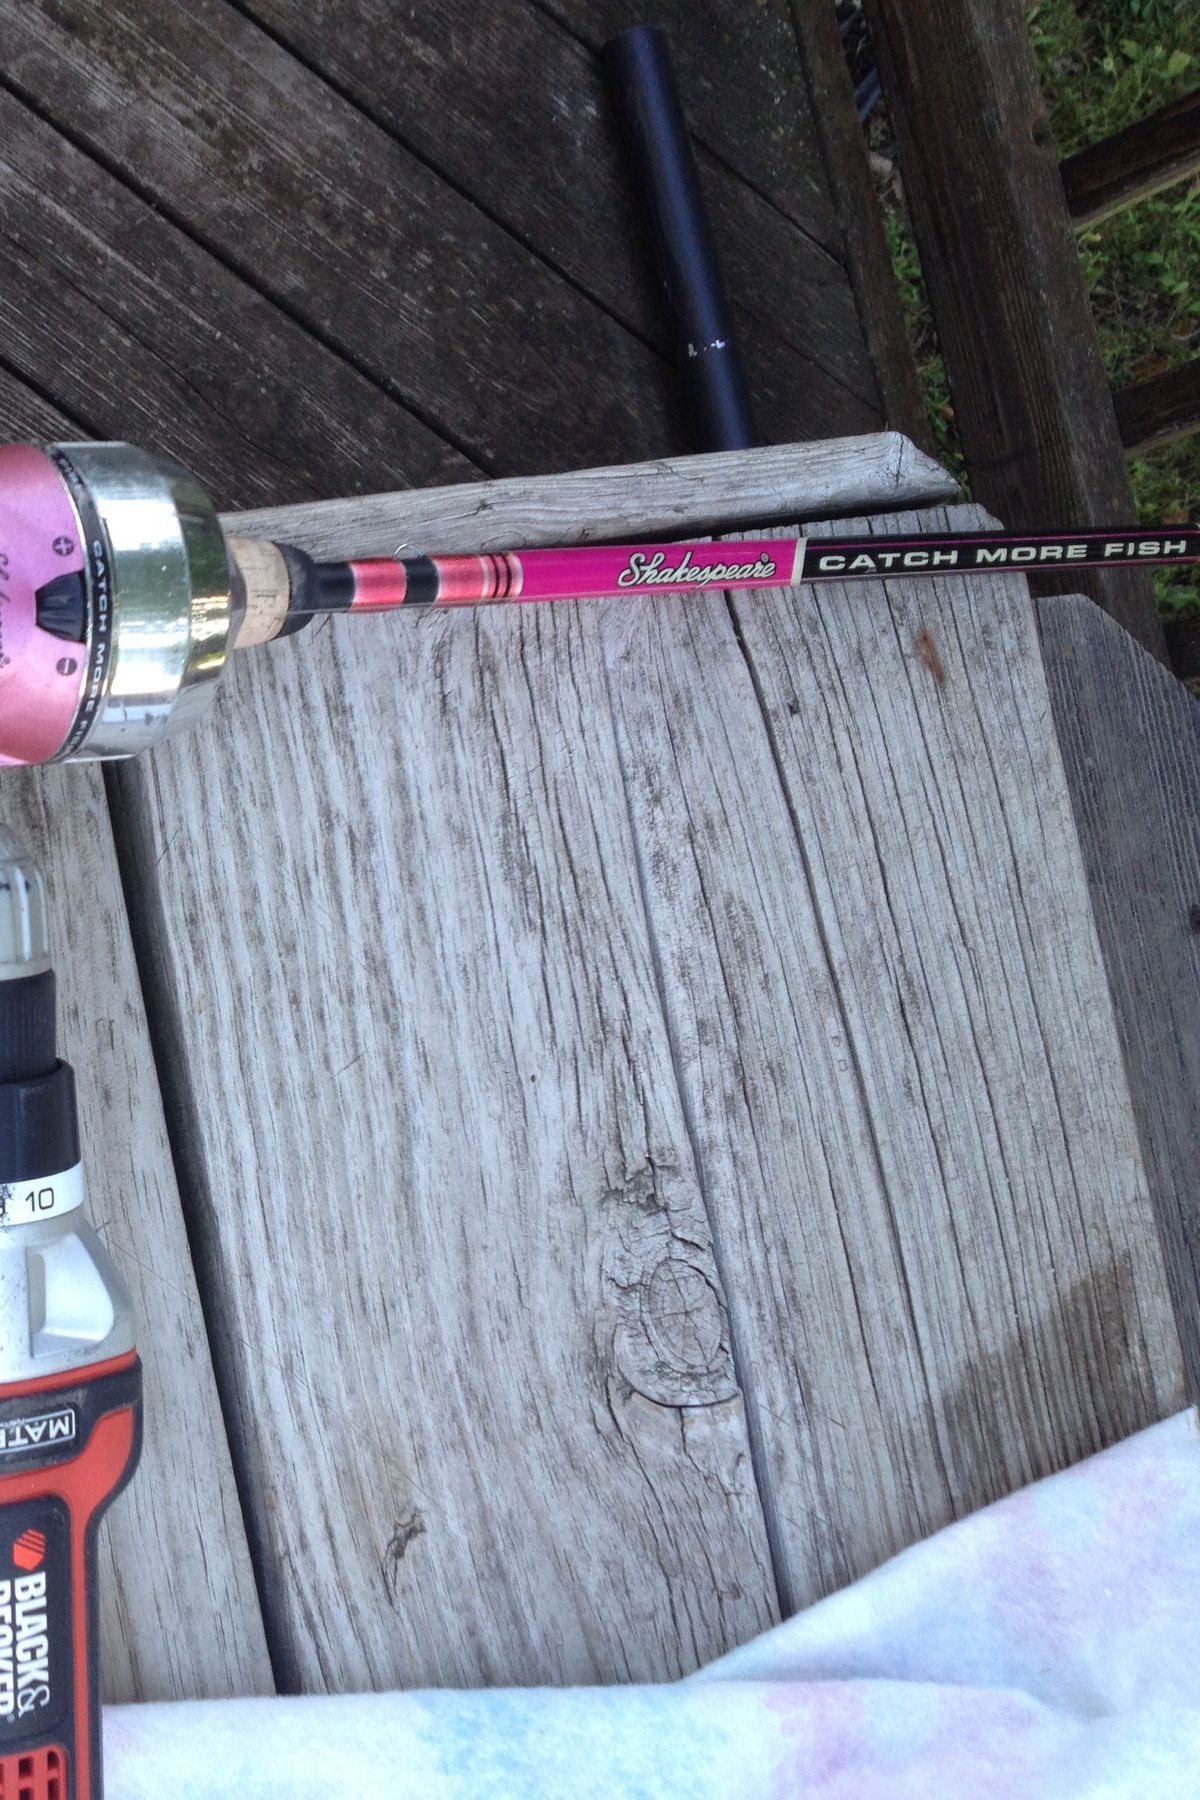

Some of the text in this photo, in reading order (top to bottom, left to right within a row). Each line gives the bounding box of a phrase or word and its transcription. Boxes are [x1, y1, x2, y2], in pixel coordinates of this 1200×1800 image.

[617, 551, 776, 588] Shakespeare
[818, 539, 1187, 571] CATCH MORE FISH
[92, 540, 107, 632] CATCH
[84, 643, 106, 713] MORE
[25, 1187, 55, 1213] 10
